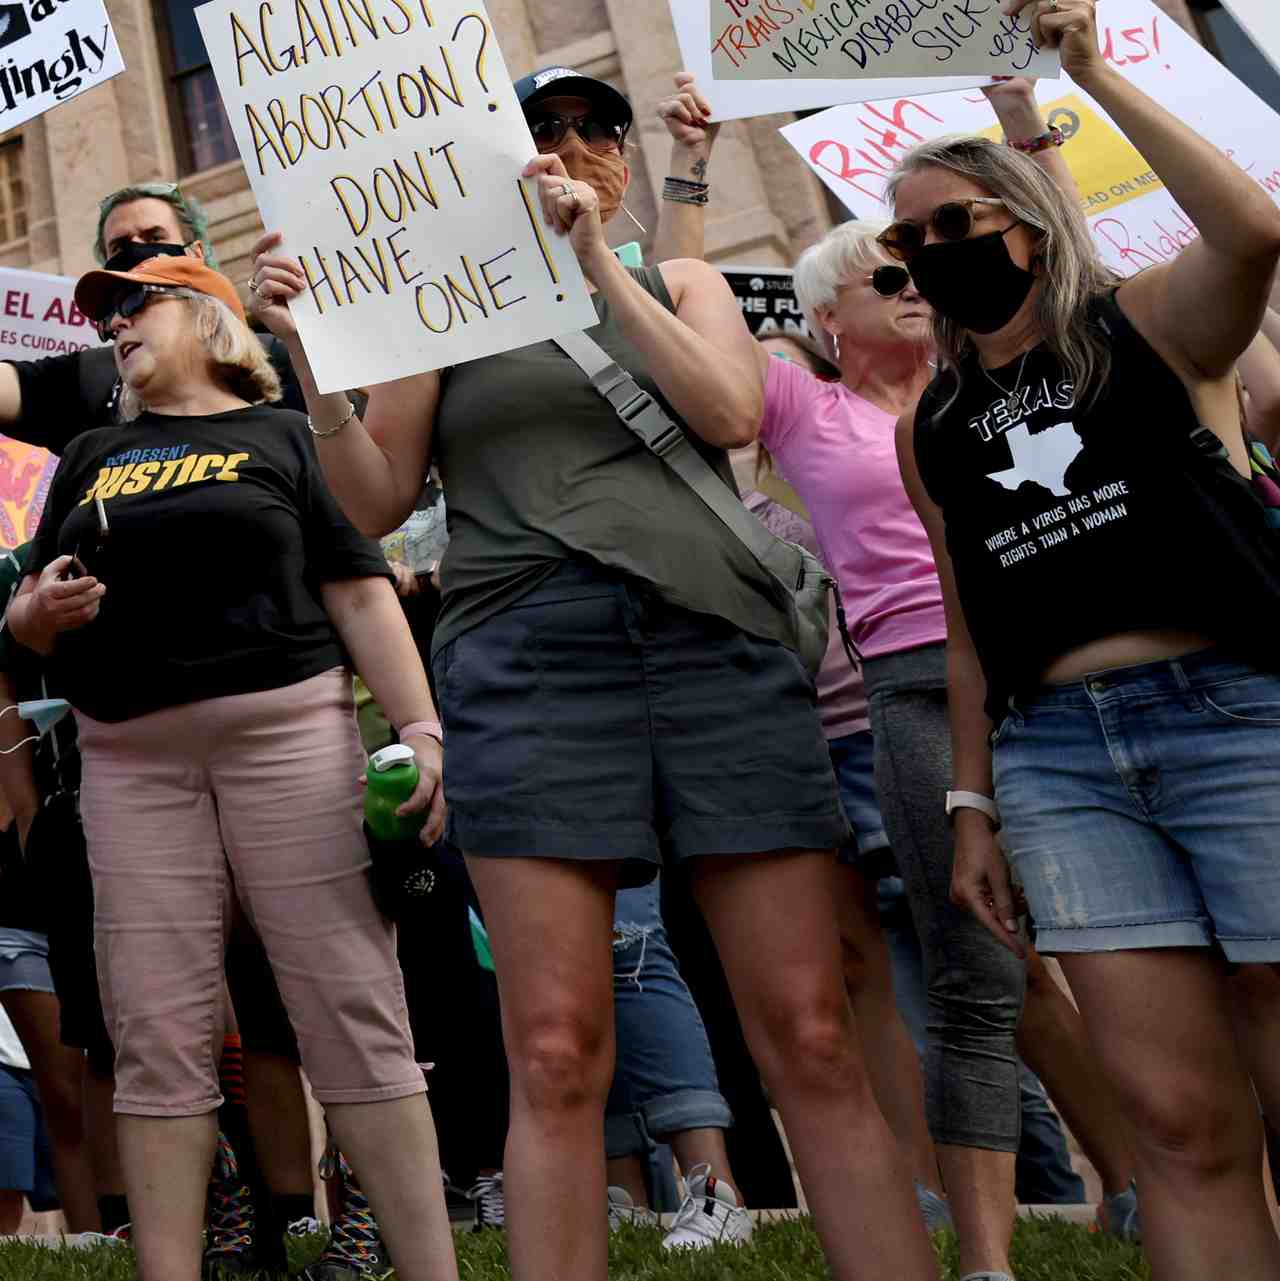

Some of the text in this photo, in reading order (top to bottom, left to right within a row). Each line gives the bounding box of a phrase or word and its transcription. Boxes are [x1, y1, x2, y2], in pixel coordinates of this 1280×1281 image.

[244, 12, 500, 176] ABORTION?
[329, 141, 470, 237] DON'T
[298, 227, 427, 315] HAVE
[4, 290, 98, 329] EL AB
[736, 296, 767, 313] HE
[0, 330, 17, 345] ES
[968, 378, 1074, 441] TEXAS
[79, 452, 249, 506] JUSTICE
[985, 480, 1129, 553] WHERE A VIRUS HAS MORE
[1000, 503, 1127, 568] RIGHTS THAN A WOMAN
